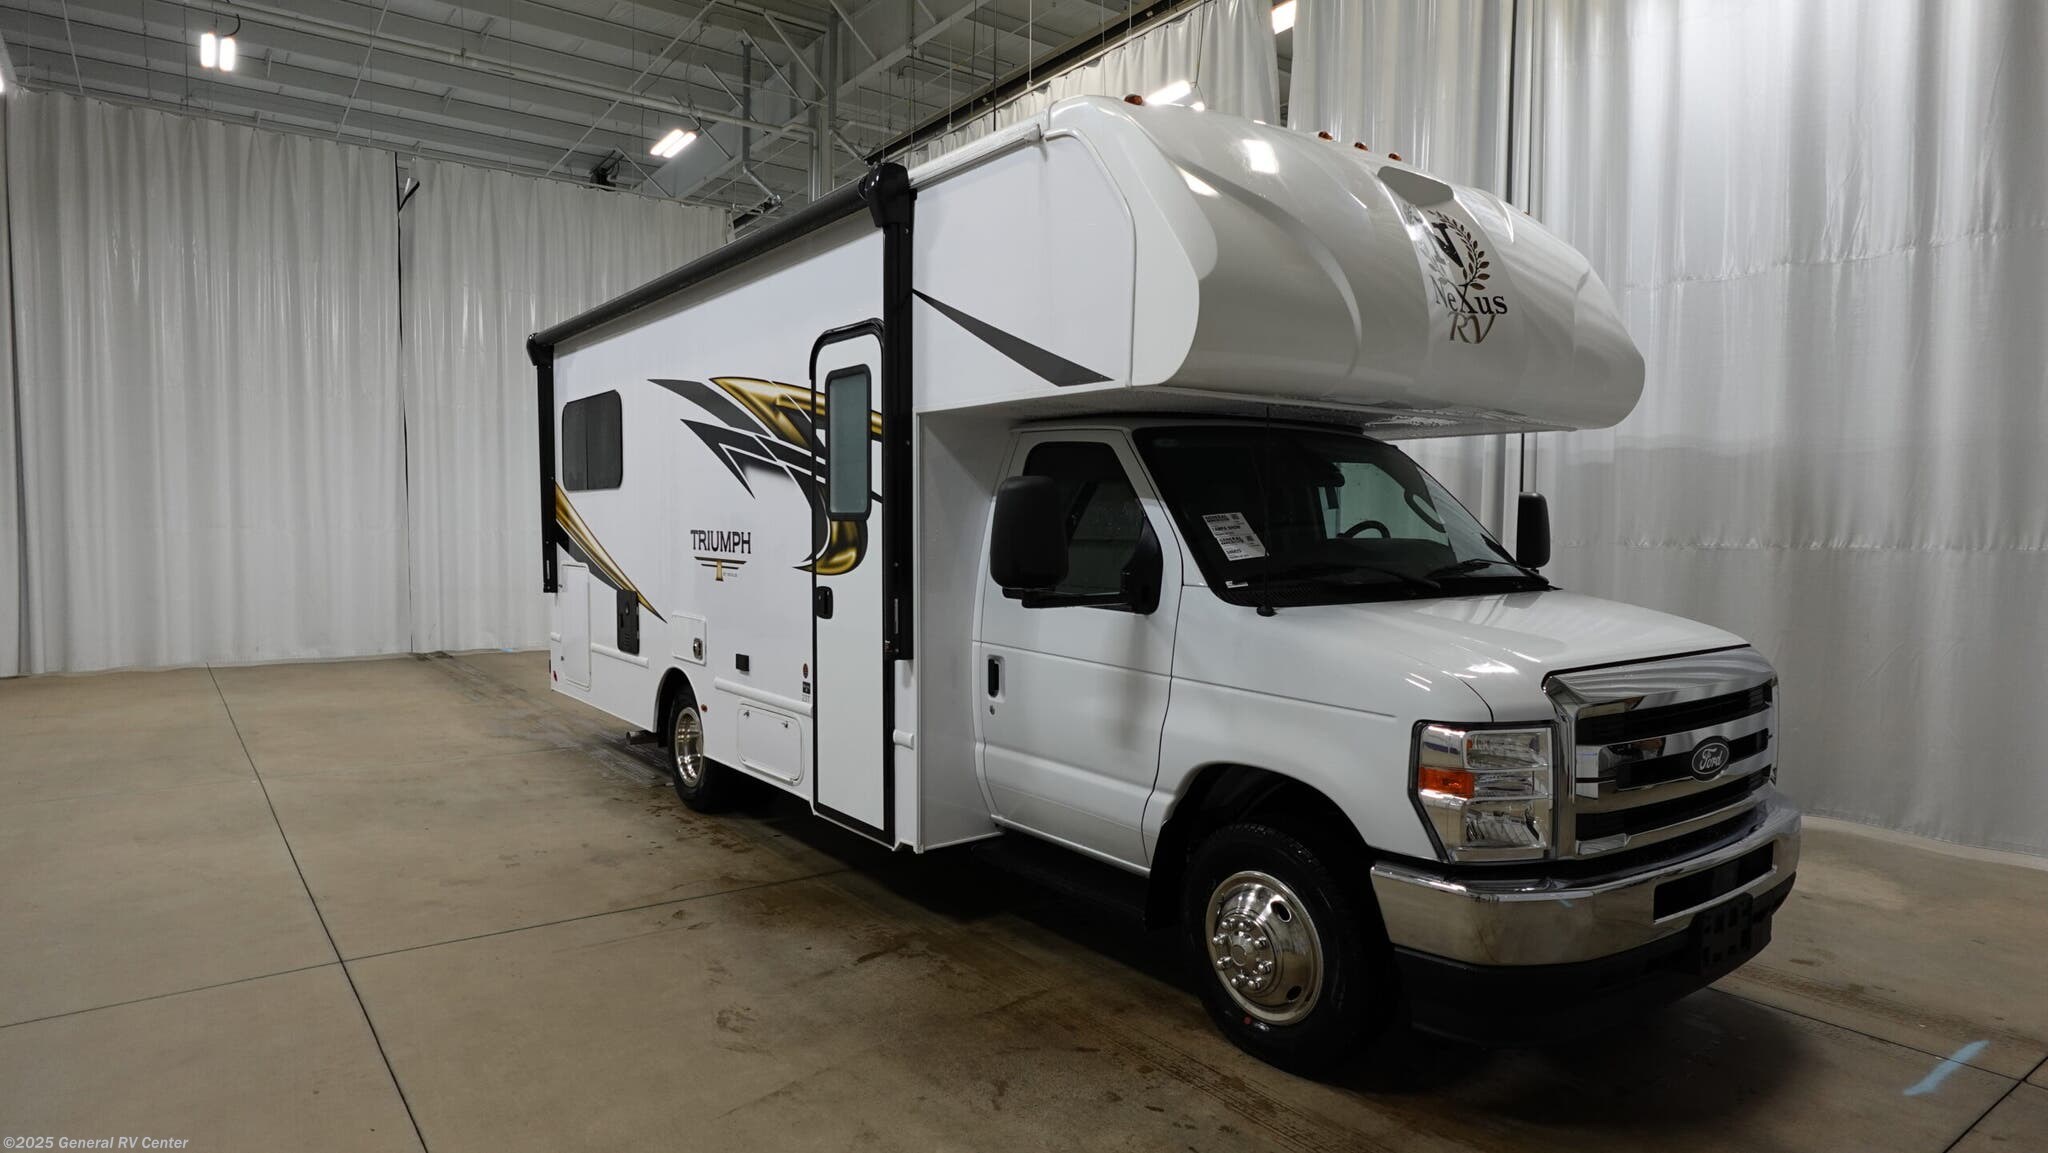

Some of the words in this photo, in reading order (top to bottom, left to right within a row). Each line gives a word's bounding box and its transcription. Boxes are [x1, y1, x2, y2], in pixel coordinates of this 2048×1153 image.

[1448, 312, 1497, 344] RV
[690, 530, 751, 554] TRIUMPH
[1699, 748, 1723, 770] Ford
